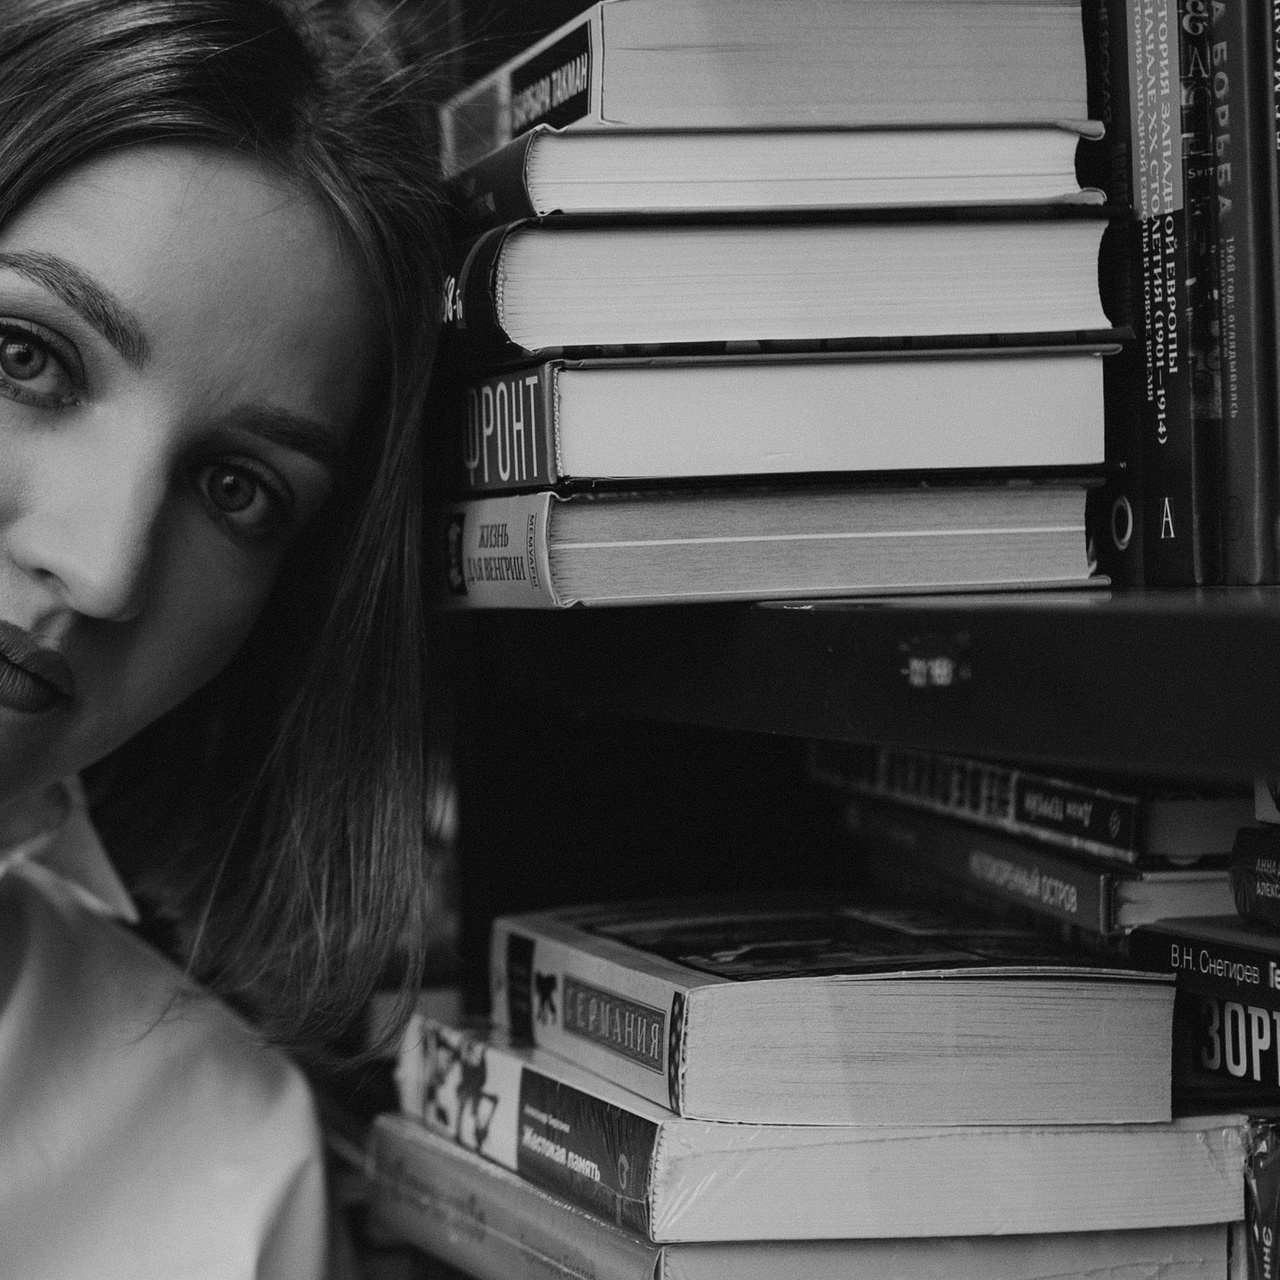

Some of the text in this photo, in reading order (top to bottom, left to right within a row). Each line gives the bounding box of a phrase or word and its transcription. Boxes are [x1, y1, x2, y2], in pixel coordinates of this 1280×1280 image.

[1212, 40, 1233, 222] БОРЬБА
[1159, 101, 1178, 256] ЗАПАДНОЙ
[1149, 159, 1163, 304] СТОЛЕТИЯ
[1225, 235, 1236, 272] 1968
[1165, 261, 1179, 375] ЕВРОПЫ
[478, 523, 510, 549] ЖИЗНЬ
[527, 514, 539, 588] МЕМУАРЫ
[484, 556, 527, 582] ВЕНГРИИ
[1041, 875, 1079, 913] ОСТРОВ
[1170, 942, 1196, 971] В.Н.
[1199, 948, 1261, 987] Снегирев
[1201, 997, 1280, 1088] ЗОР
[567, 1150, 602, 1183] память
